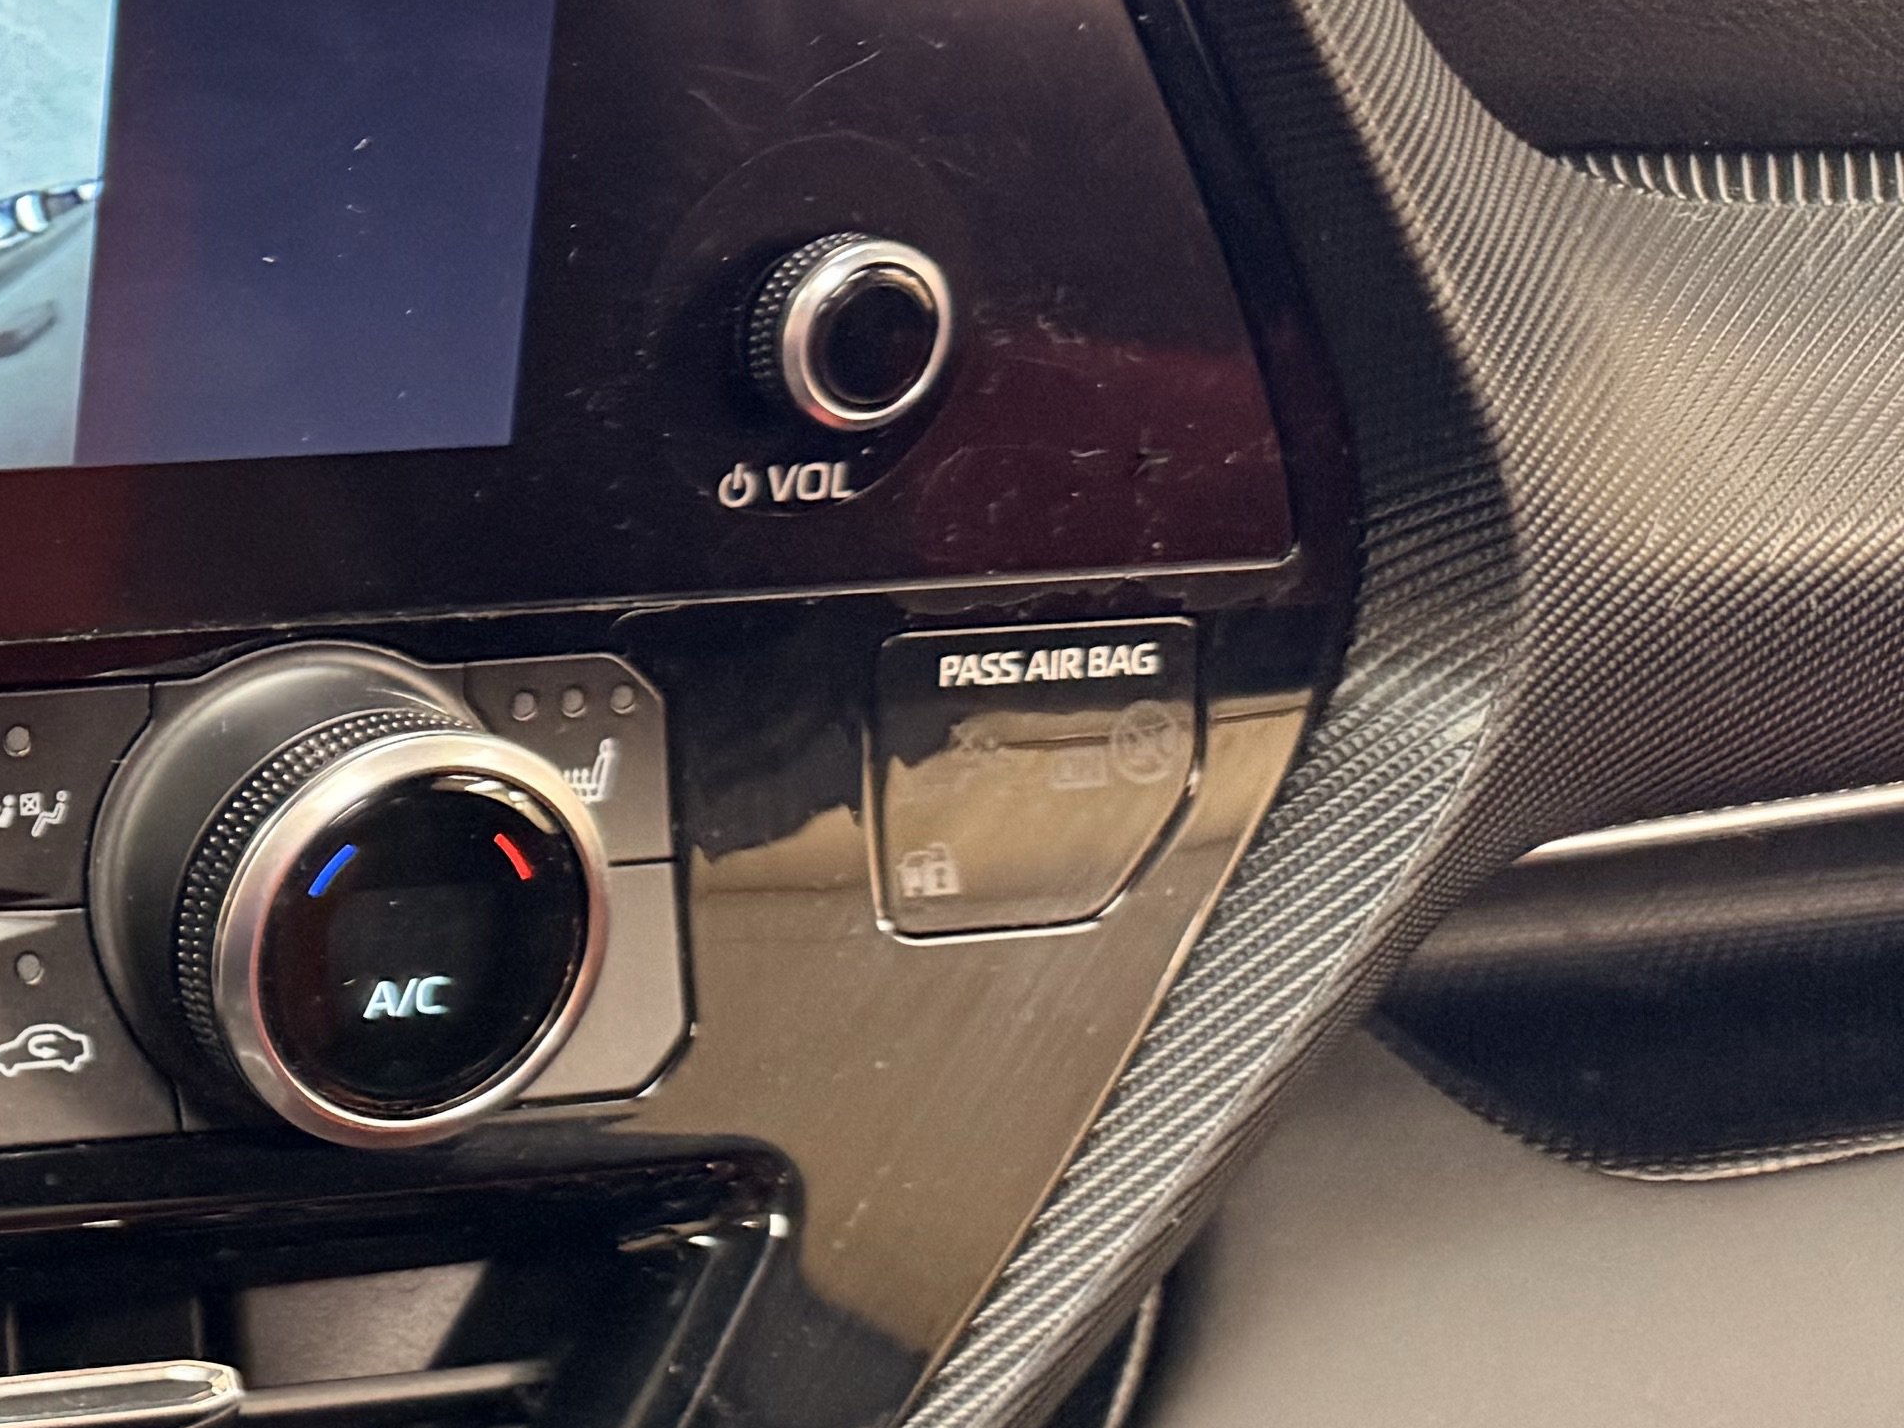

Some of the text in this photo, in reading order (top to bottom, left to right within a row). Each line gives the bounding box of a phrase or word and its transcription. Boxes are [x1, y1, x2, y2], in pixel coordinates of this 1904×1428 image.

[768, 462, 852, 502] VOL
[939, 642, 1160, 687] PASS AIR BAG
[363, 976, 451, 1019] A/C
